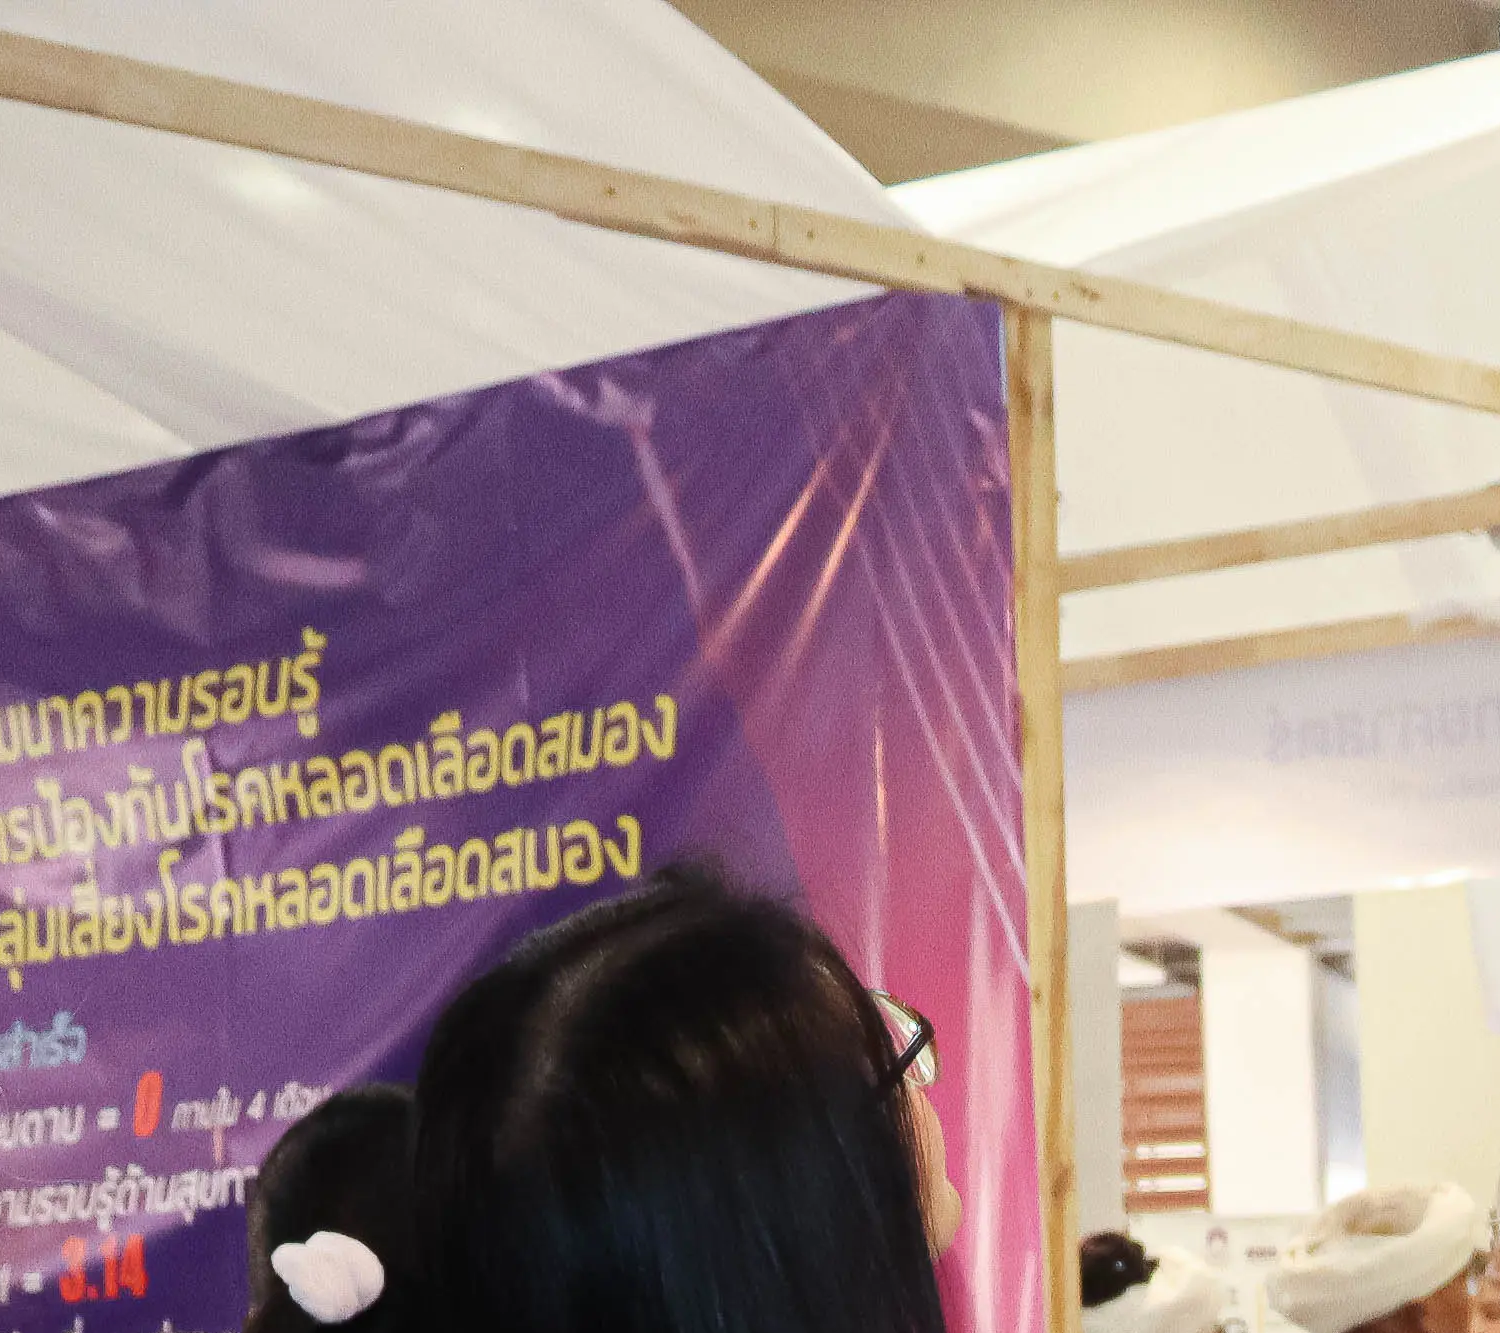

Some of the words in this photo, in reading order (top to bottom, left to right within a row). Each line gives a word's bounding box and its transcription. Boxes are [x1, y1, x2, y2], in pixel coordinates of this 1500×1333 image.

[134, 1070, 162, 1138] 0
[246, 1090, 267, 1121] 4
[59, 1234, 148, 1303] 3.14
